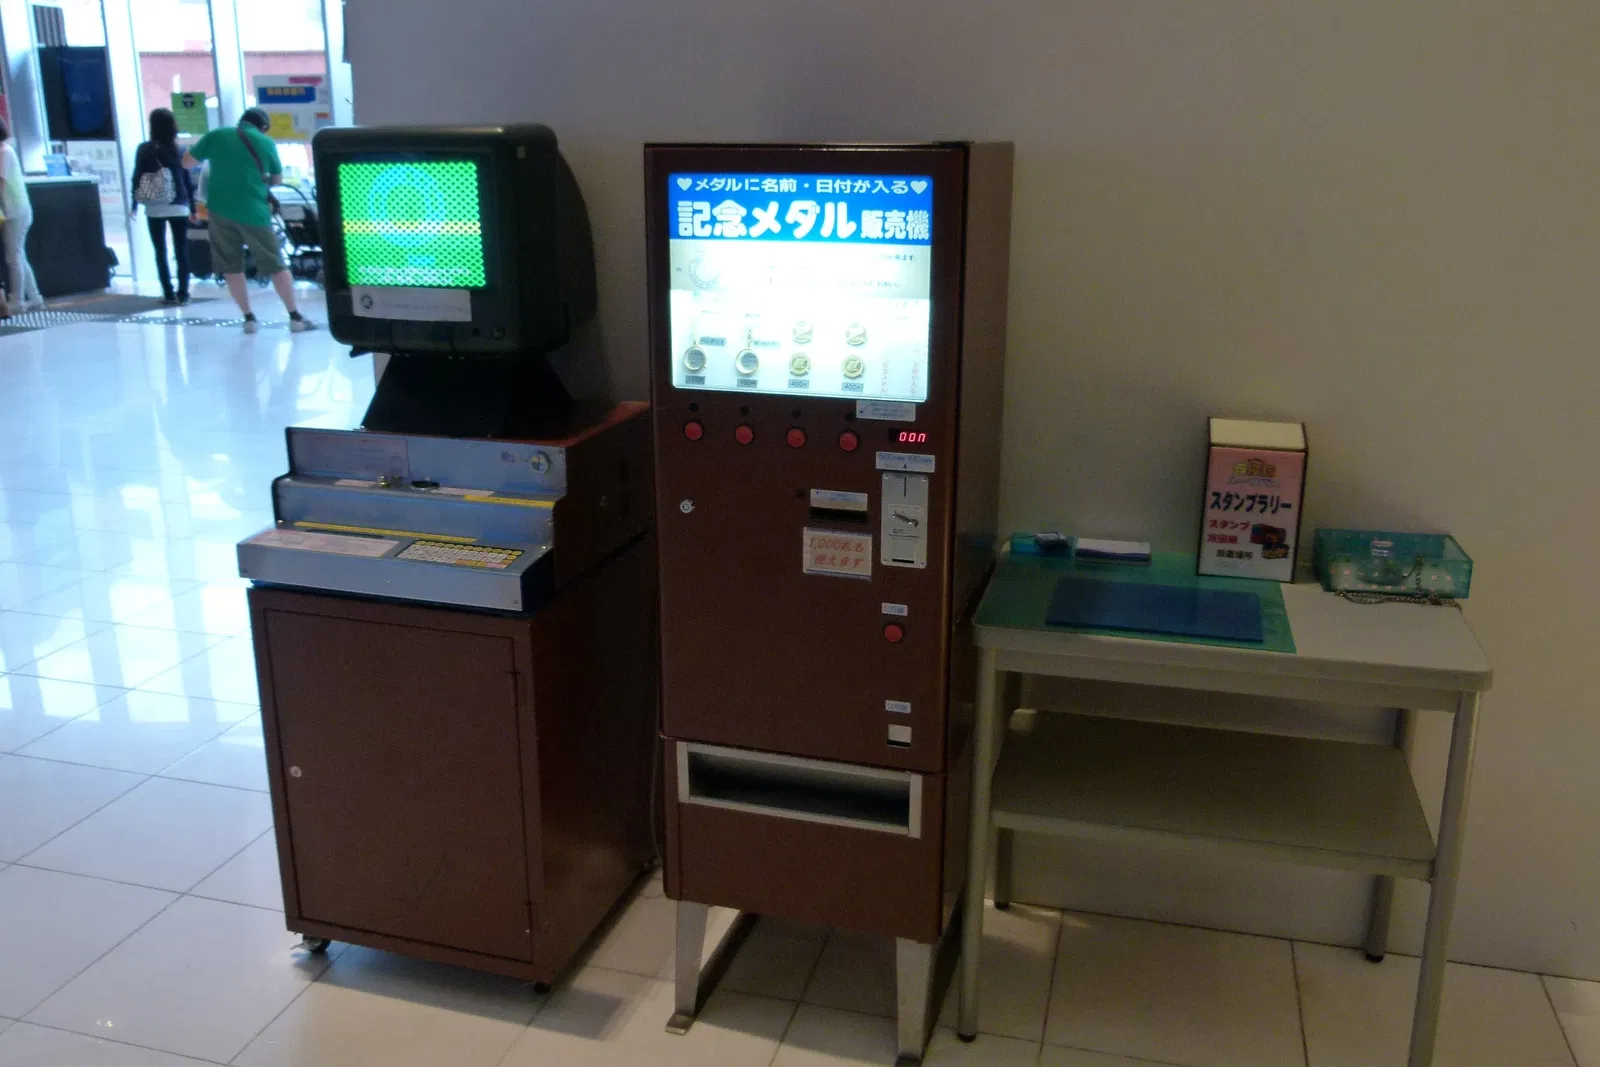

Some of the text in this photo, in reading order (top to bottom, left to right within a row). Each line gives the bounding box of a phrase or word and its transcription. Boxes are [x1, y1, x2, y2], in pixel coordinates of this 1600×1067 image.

[677, 199, 929, 240] 記念メダル 販売機
[1210, 491, 1292, 514] スタンプラリー
[1209, 519, 1250, 531] スタンプ
